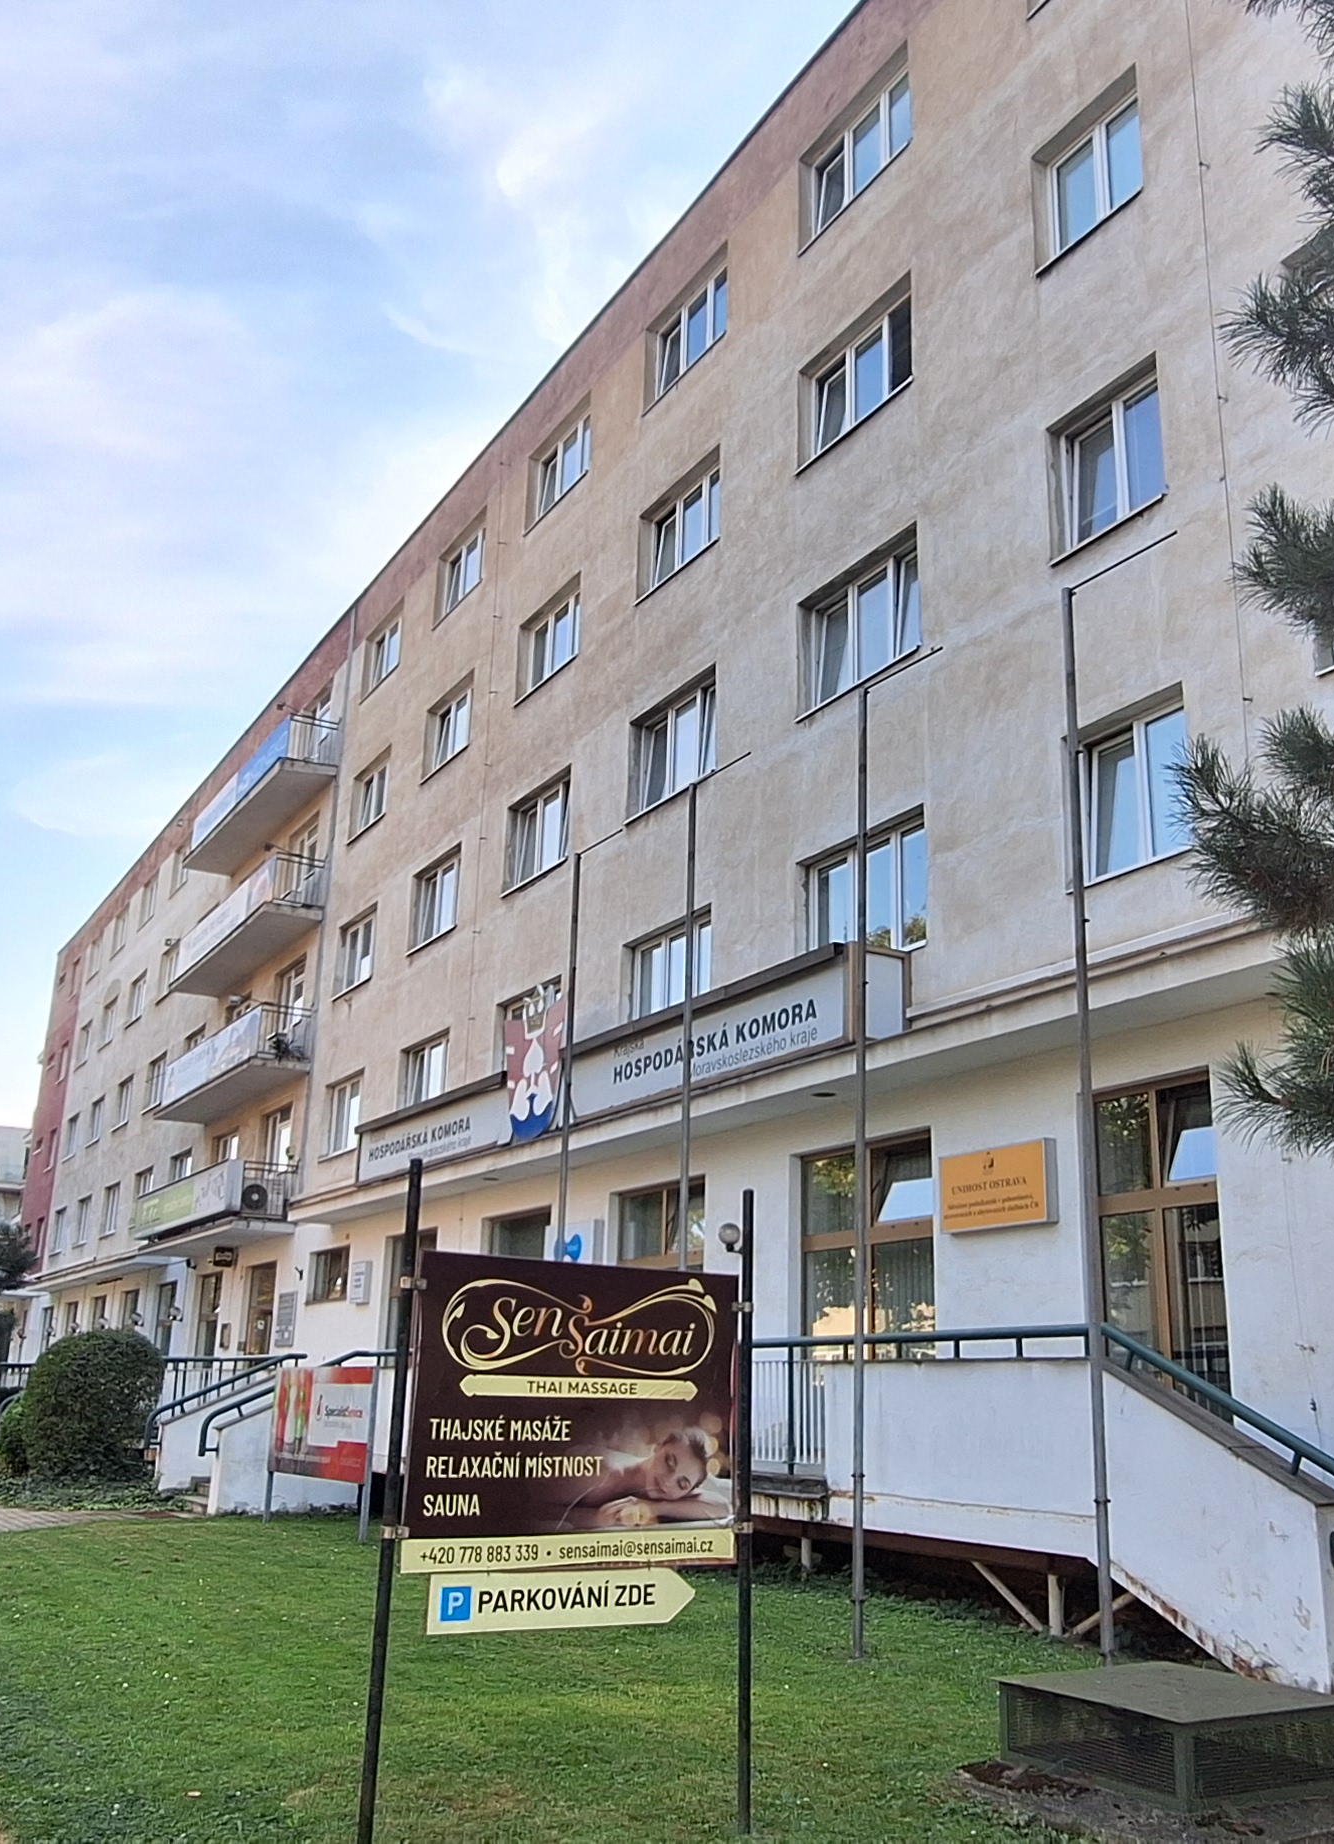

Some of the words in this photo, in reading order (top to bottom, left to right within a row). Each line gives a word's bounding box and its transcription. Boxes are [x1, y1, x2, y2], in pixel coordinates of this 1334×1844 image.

[735, 998, 818, 1045] KOMORA
[692, 1035, 787, 1078] oravskoslezského
[790, 1026, 818, 1047] kraje
[431, 1116, 471, 1142] KOMORA
[989, 1176, 1027, 1190] OSTRAVA
[461, 1296, 563, 1359] Sen
[526, 1380, 563, 1394] THAI
[567, 1381, 638, 1396] MASSAGE
[430, 1414, 506, 1442] THAJSKÉ
[510, 1415, 572, 1442] MASÁŽE
[425, 1451, 521, 1479] RELAXAČNÍ
[524, 1452, 604, 1479] MÍSTNOST
[422, 1493, 481, 1517] SAUNA
[420, 1546, 455, 1564] +420
[459, 1546, 482, 1563] 778
[486, 1545, 511, 1562] 883
[515, 1543, 539, 1561] 339
[559, 1539, 714, 1560] sensaimai@sensaimai.cz
[448, 1590, 464, 1616] P
[477, 1581, 609, 1614] PARKOVÁNÍ
[614, 1583, 656, 1607] ZDE
